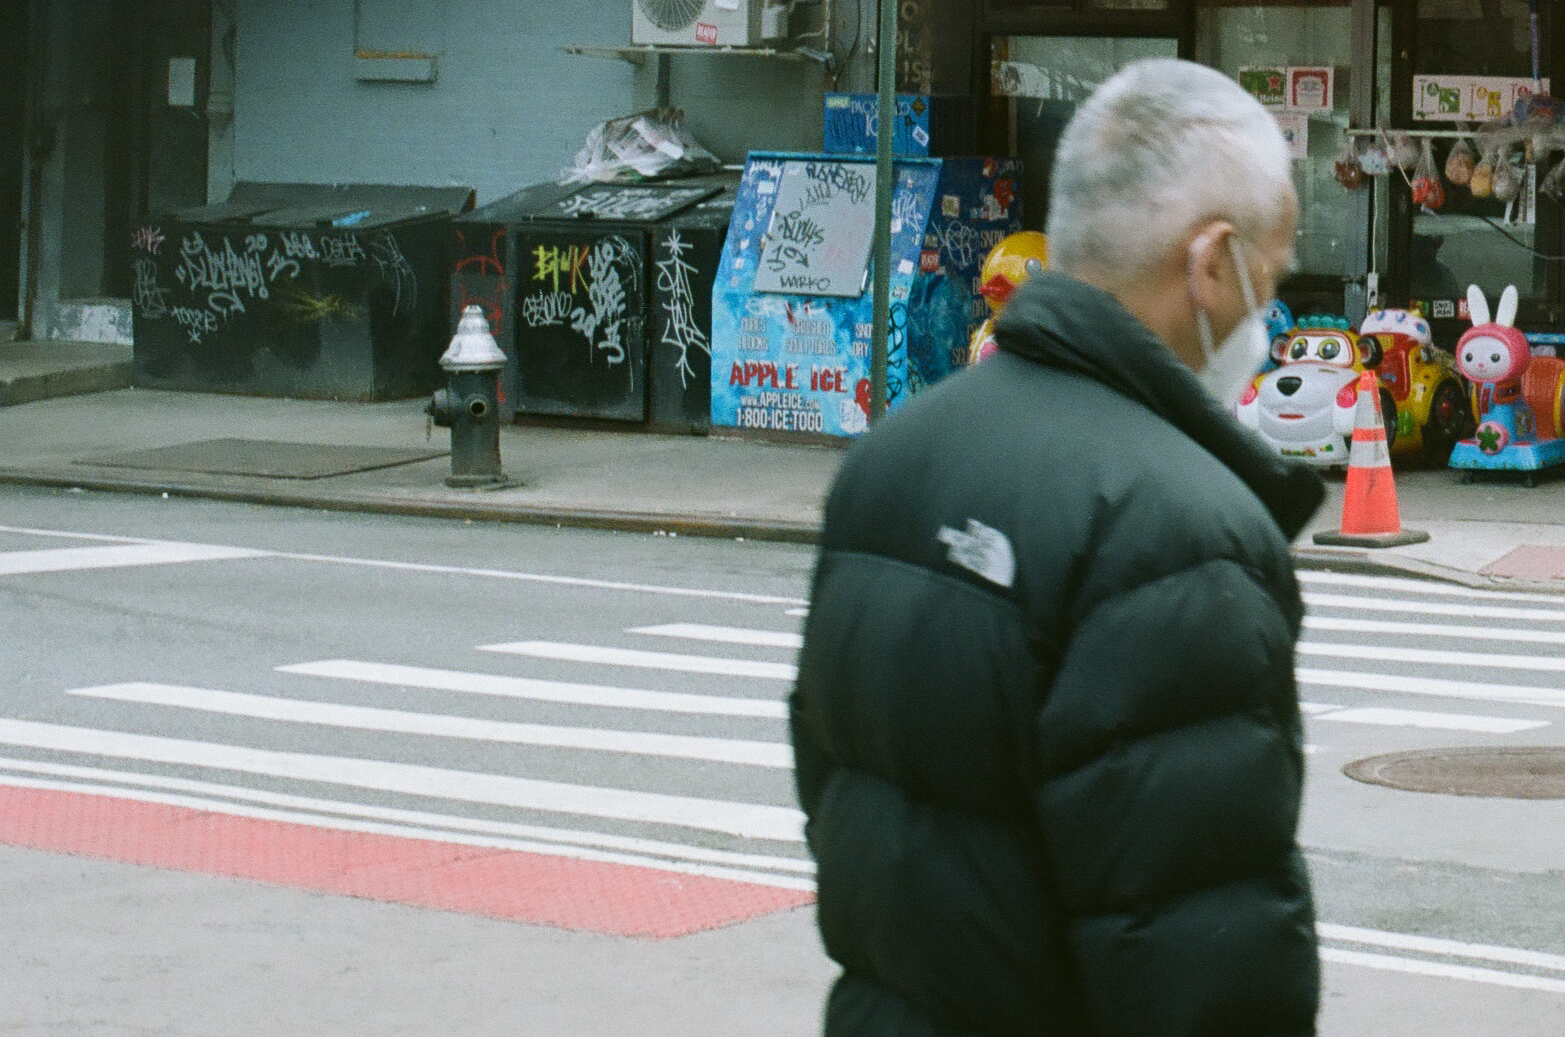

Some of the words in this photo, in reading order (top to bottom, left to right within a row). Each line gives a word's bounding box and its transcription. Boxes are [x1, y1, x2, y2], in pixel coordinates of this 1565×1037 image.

[855, 323, 873, 339] SNO
[852, 341, 869, 358] DRY
[729, 359, 798, 391] APPLE
[810, 364, 848, 394] ICE
[736, 407, 823, 433] 1-800-ICE-TOGO
